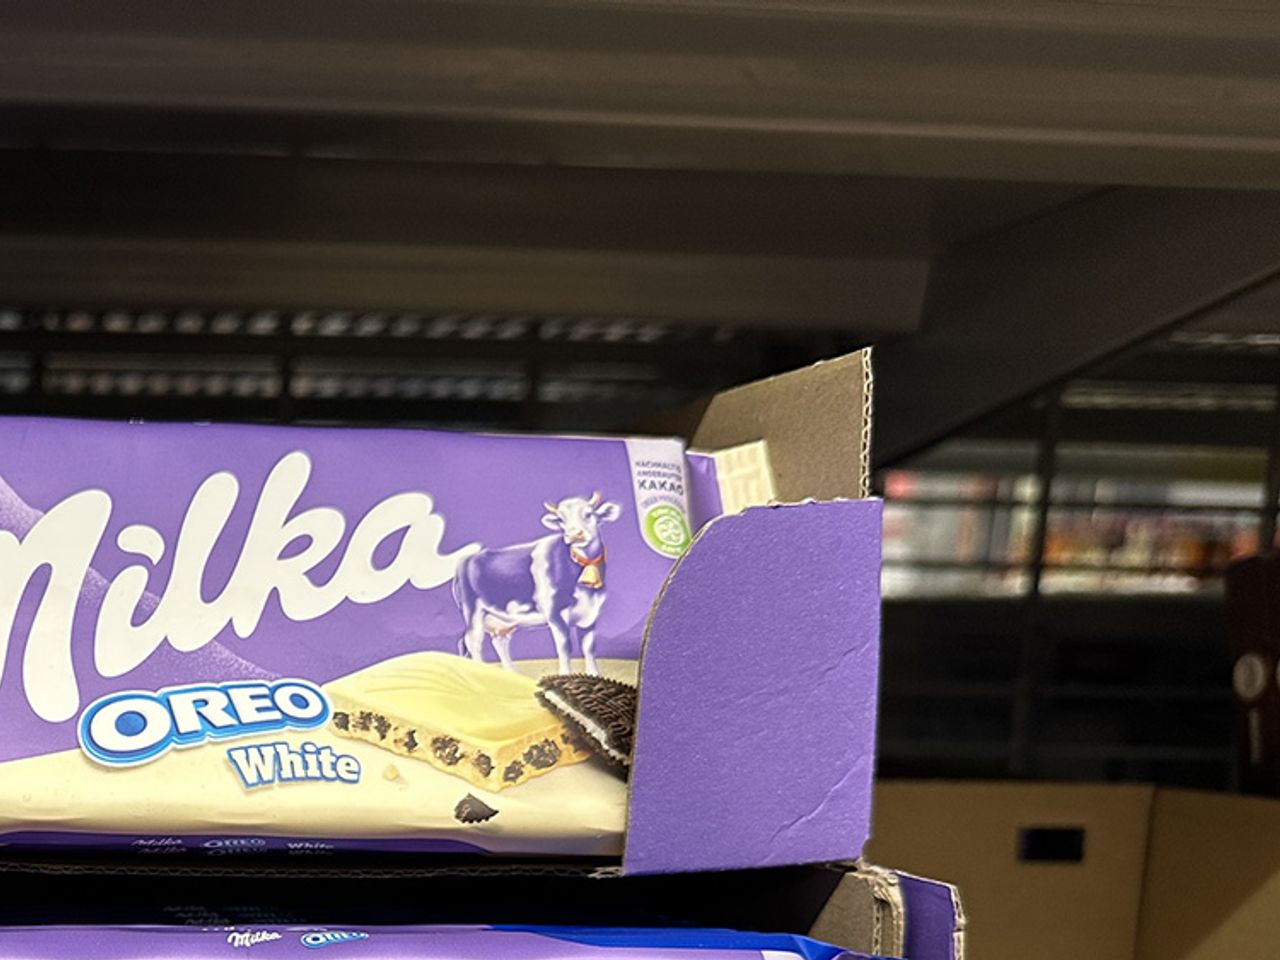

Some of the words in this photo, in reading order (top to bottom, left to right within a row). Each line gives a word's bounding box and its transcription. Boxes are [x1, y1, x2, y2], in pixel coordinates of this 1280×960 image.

[638, 479, 684, 496] KAKAO
[87, 683, 328, 755] OREO
[228, 744, 363, 791] White
[226, 931, 283, 948] Milka
